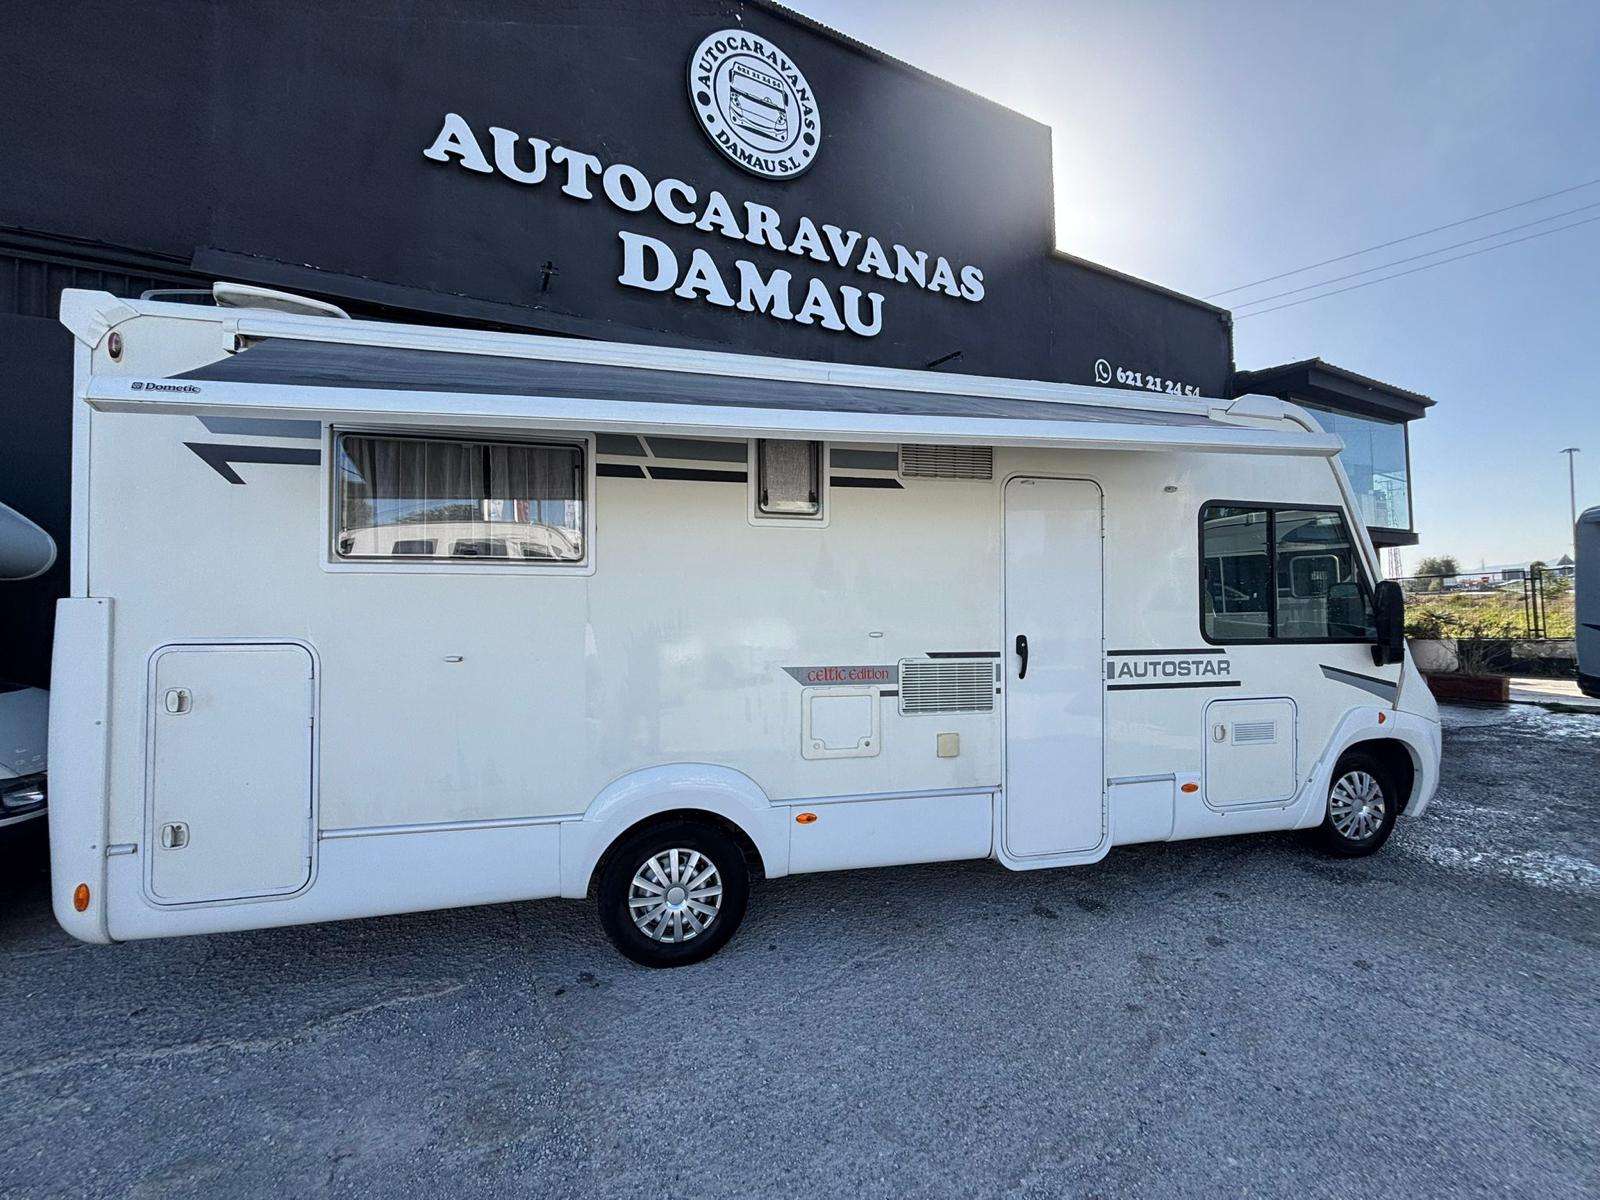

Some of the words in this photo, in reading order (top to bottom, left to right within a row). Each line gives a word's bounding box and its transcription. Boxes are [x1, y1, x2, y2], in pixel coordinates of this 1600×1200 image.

[698, 37, 815, 130] AUTOCARAVANAS
[715, 129, 776, 172] DAMAU
[423, 113, 985, 302] AUTOCARAVANAS
[618, 231, 885, 337] DAMAU
[145, 382, 202, 394] Dometic
[1116, 366, 1143, 387] 621
[1146, 375, 1163, 392] 21
[1165, 380, 1182, 397] 24
[1184, 385, 1200, 397] 54
[1117, 660, 1231, 678] AUTOSTAR
